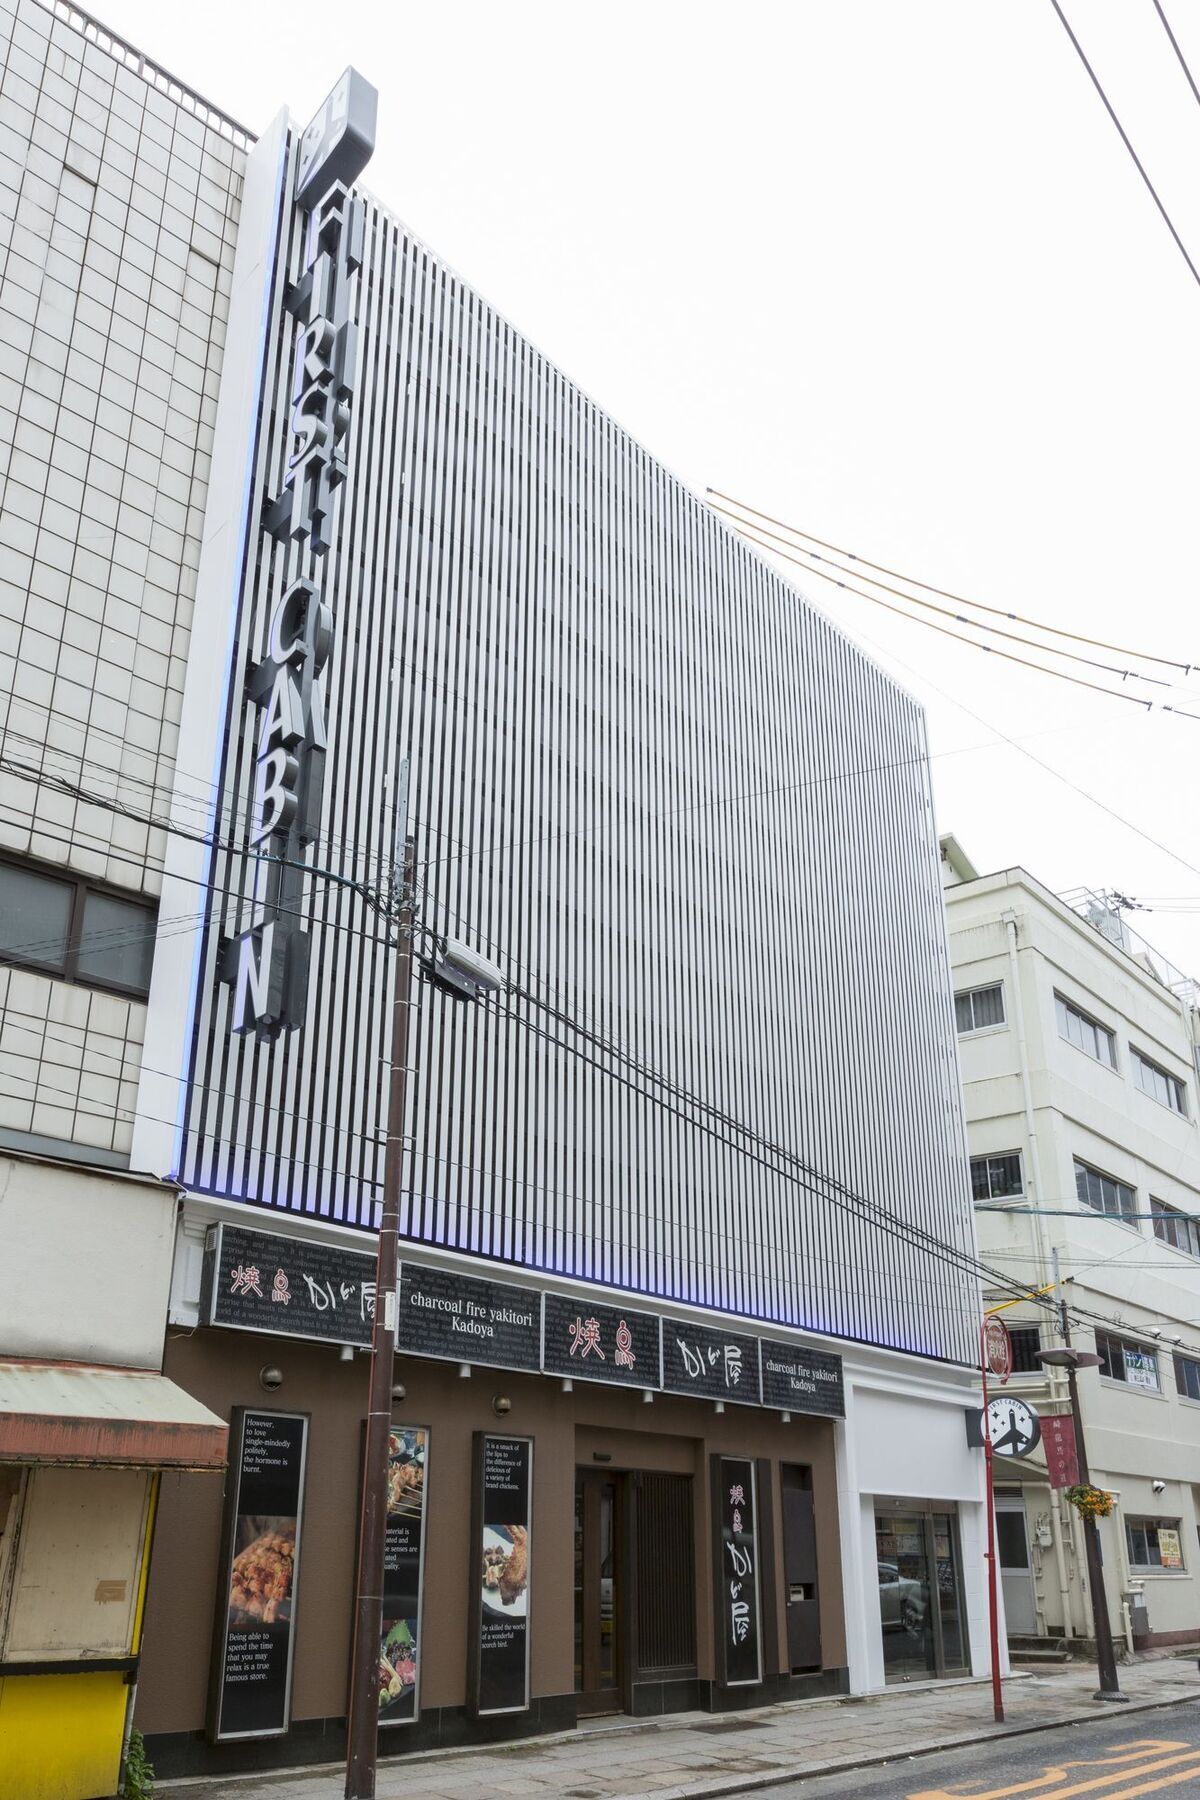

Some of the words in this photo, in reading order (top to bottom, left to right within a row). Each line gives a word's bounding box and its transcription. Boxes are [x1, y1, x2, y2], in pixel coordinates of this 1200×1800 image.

[286, 178, 350, 548] FIRST
[232, 577, 314, 1036] CABIN
[410, 1291, 462, 1314] charcoal
[466, 1301, 487, 1319] fire
[489, 1307, 533, 1327] yakitori
[451, 1316, 494, 1338] Kadoya
[766, 1360, 795, 1376] charcoal
[797, 1365, 810, 1378] fire
[811, 1368, 838, 1383] yakitori
[790, 1377, 816, 1393] Kadoya
[254, 1428, 267, 1436] love
[245, 1437, 291, 1448] single-mindedly
[243, 1455, 254, 1463] the
[255, 1456, 281, 1465] hormone
[404, 1527, 410, 1535] is
[229, 1633, 247, 1642] Being
[248, 1632, 261, 1640] able
[228, 1643, 247, 1652] spend
[248, 1642, 259, 1650] the
[227, 1654, 240, 1662] that
[241, 1654, 253, 1662] you
[254, 1653, 268, 1661] may
[226, 1663, 242, 1672] relax
[225, 1674, 248, 1682] famous
